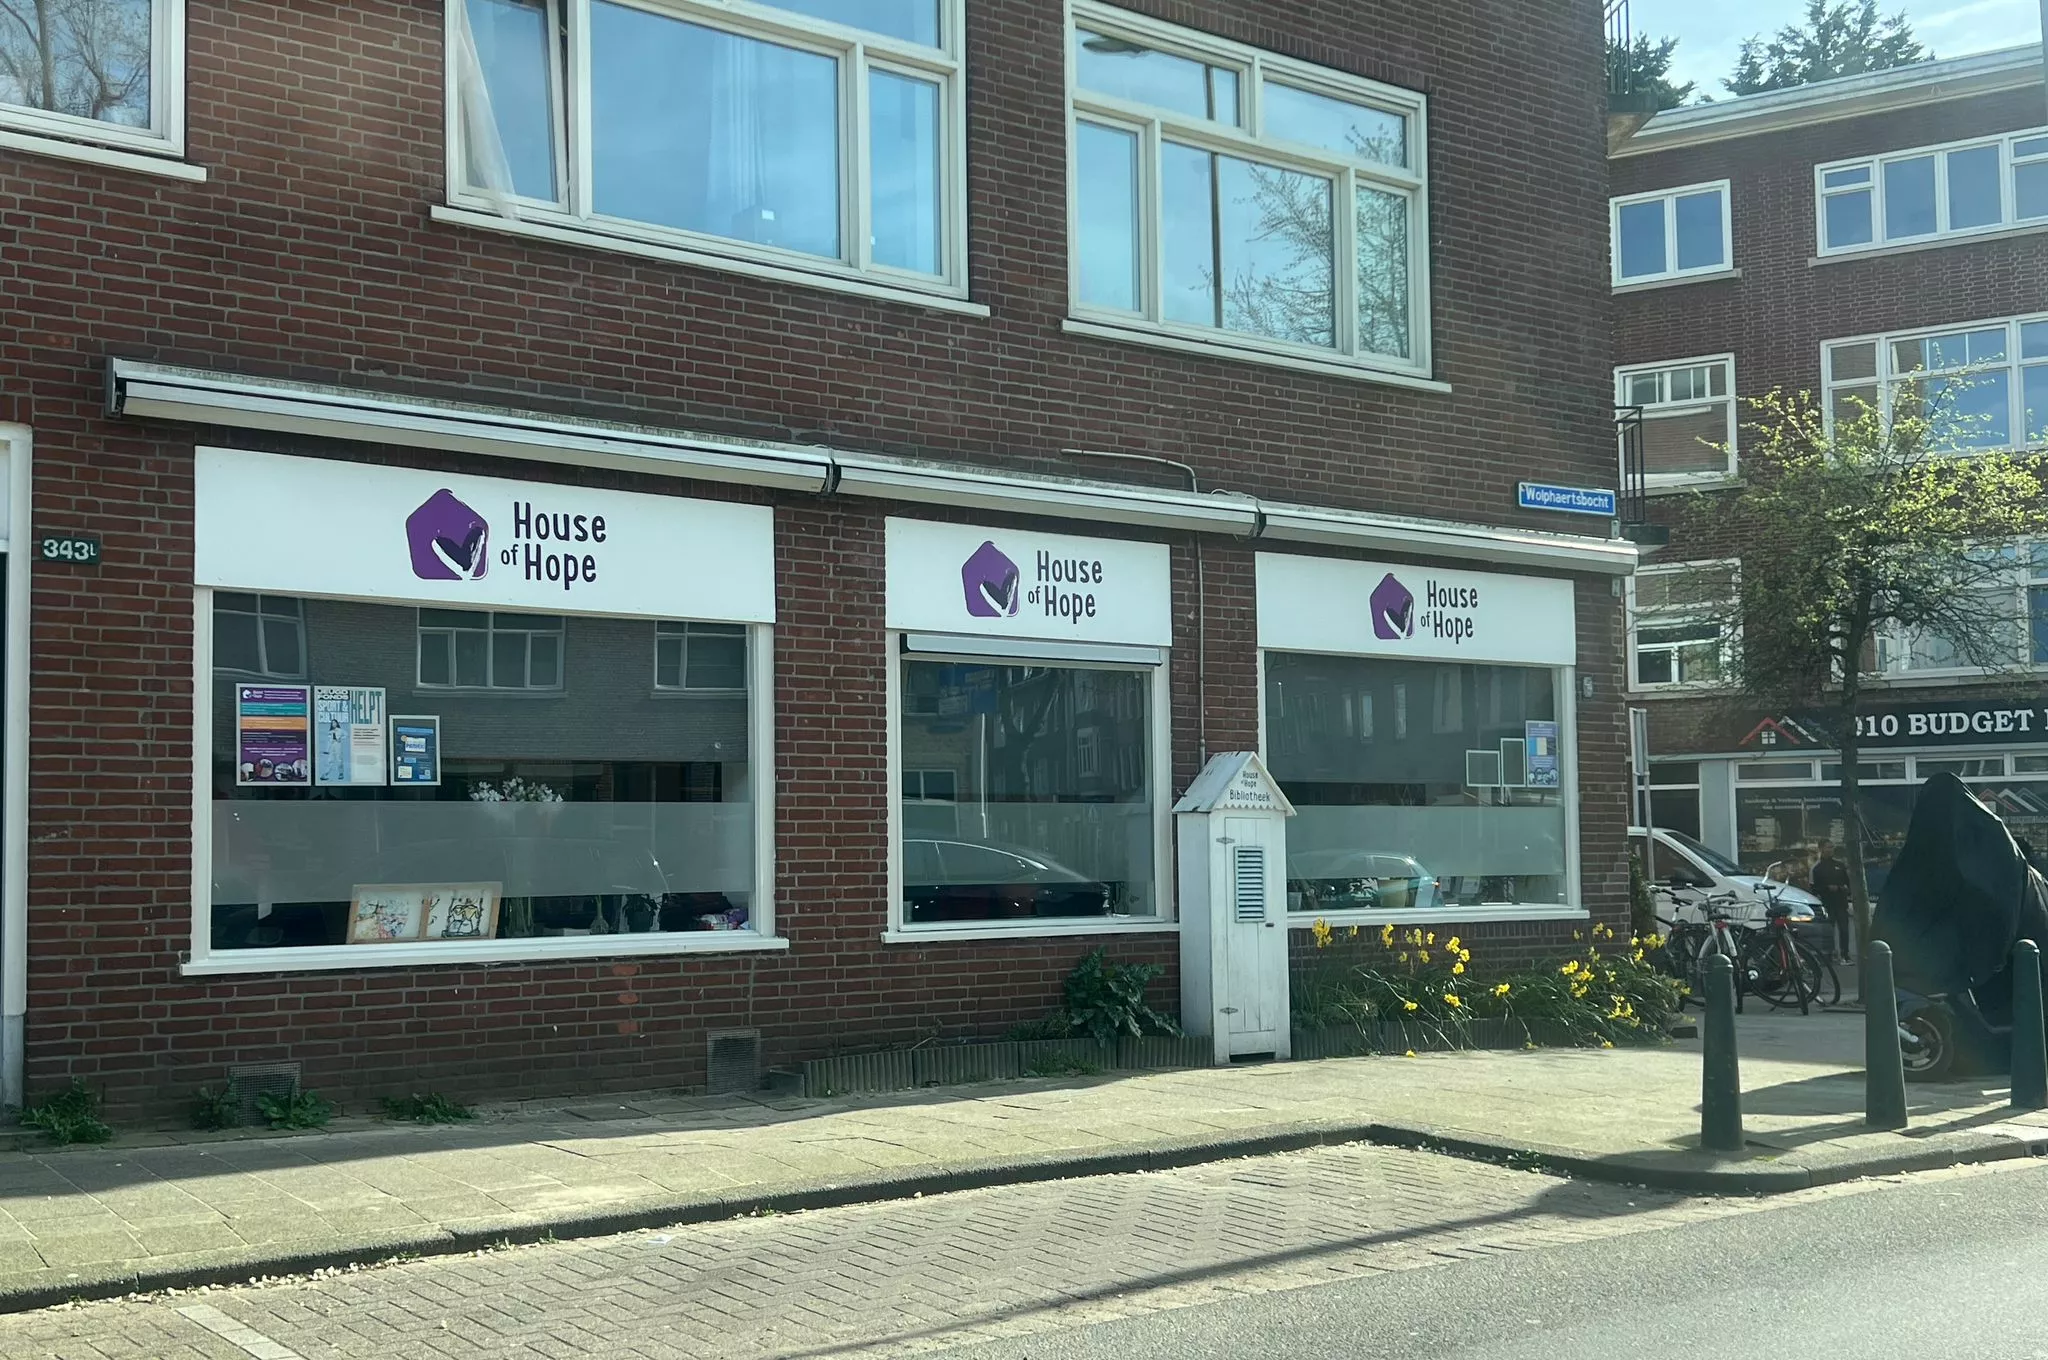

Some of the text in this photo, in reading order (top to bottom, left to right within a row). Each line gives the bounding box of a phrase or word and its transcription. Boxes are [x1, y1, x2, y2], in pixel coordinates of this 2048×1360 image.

[1525, 487, 1609, 508] Wolphaertsbocht
[513, 501, 607, 543] House
[500, 543, 597, 591] of Hope
[1036, 550, 1103, 584] House
[1027, 585, 1097, 625] of Hope
[1426, 580, 1478, 608] House
[1420, 610, 1474, 645] of Hope
[350, 690, 382, 725] HELPT
[1907, 709, 2035, 736] BUDGET
[1229, 789, 1272, 802] Bibliotheek
